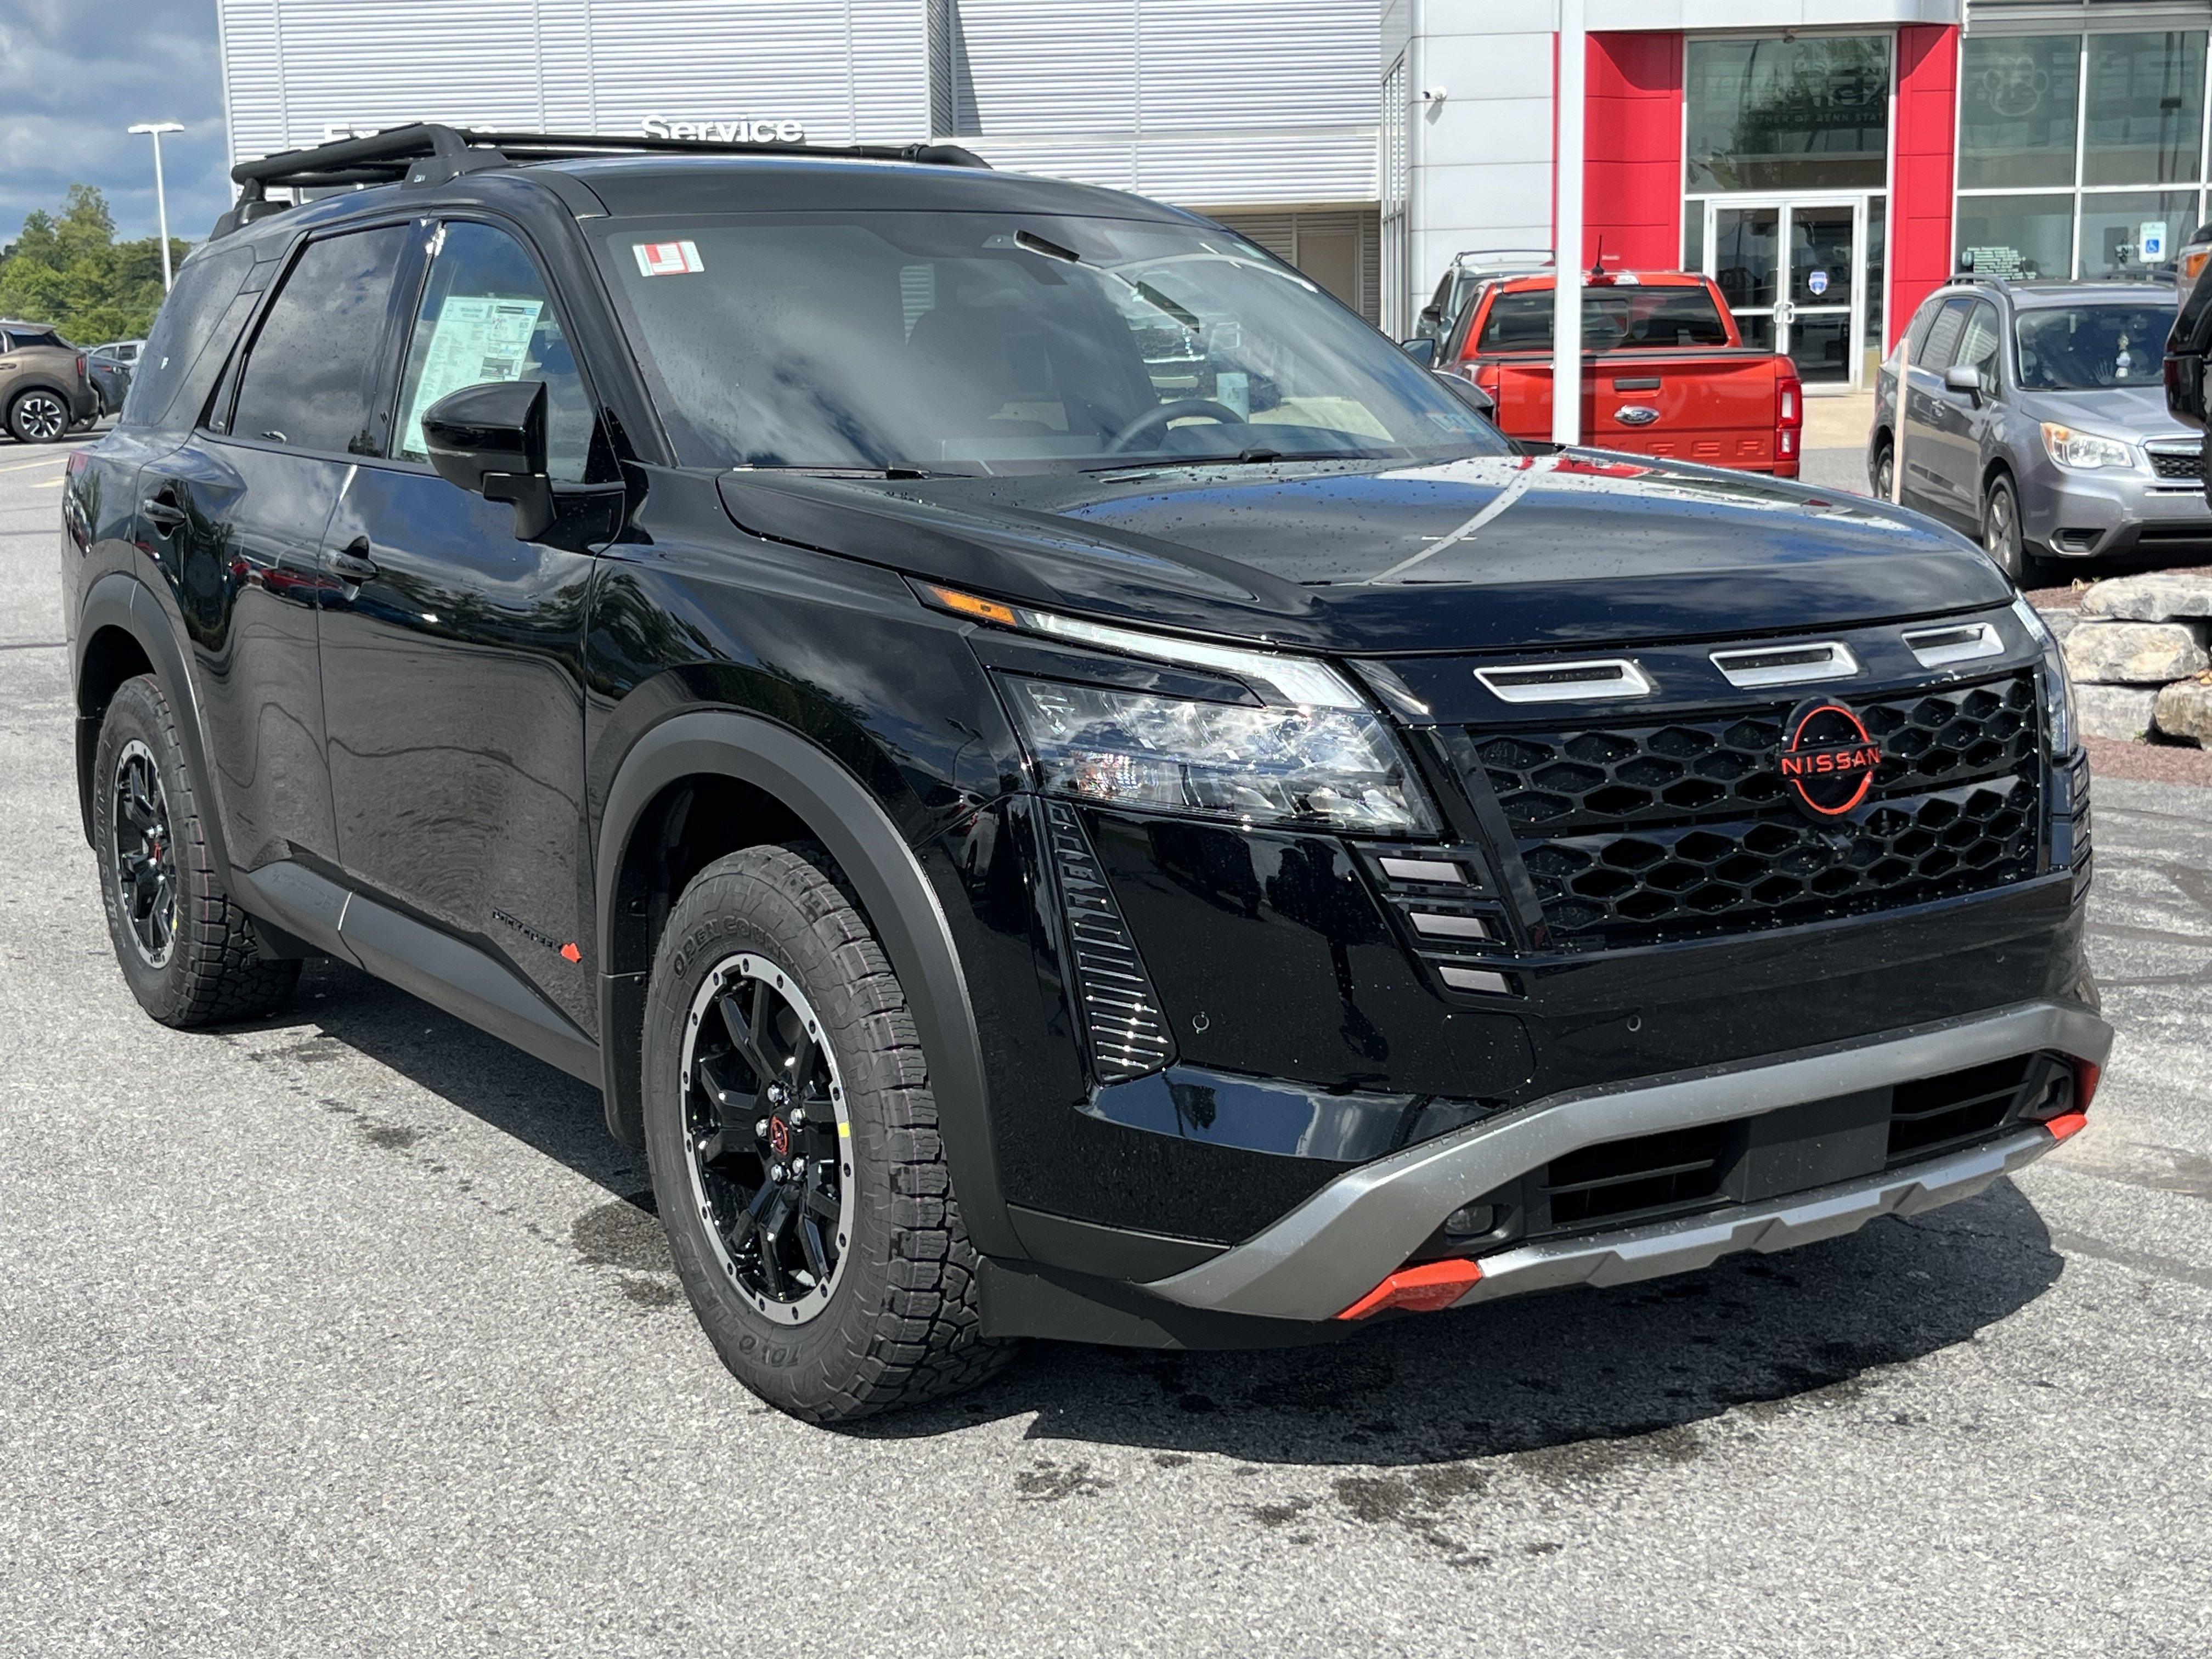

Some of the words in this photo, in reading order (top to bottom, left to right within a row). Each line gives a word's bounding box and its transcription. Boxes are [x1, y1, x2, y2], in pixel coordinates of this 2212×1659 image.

[641, 115, 804, 142] Service
[1781, 747, 1881, 775] NISSAN
[674, 918, 721, 980] OPEN
